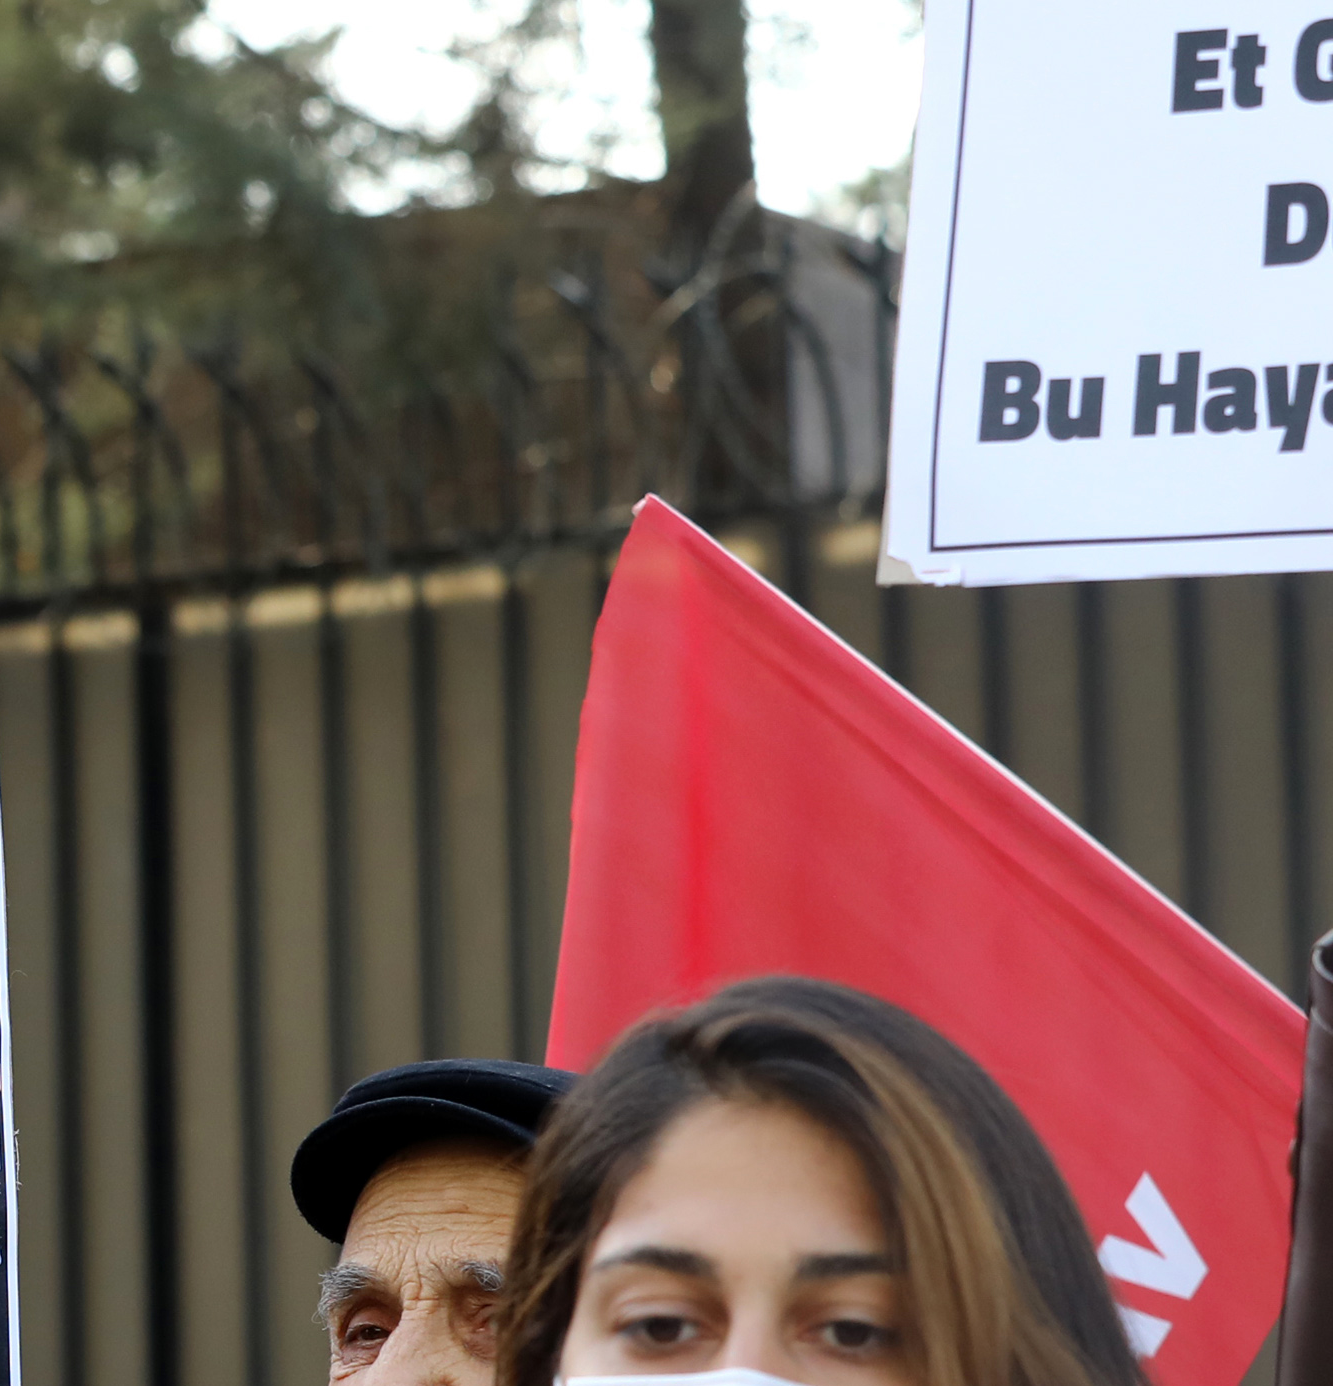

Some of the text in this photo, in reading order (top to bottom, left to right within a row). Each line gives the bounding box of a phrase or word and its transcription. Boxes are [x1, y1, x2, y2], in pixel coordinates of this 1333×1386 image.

[1172, 28, 1266, 113] Et
[1264, 182, 1333, 266] D
[979, 351, 1333, 452] Bu Hay
